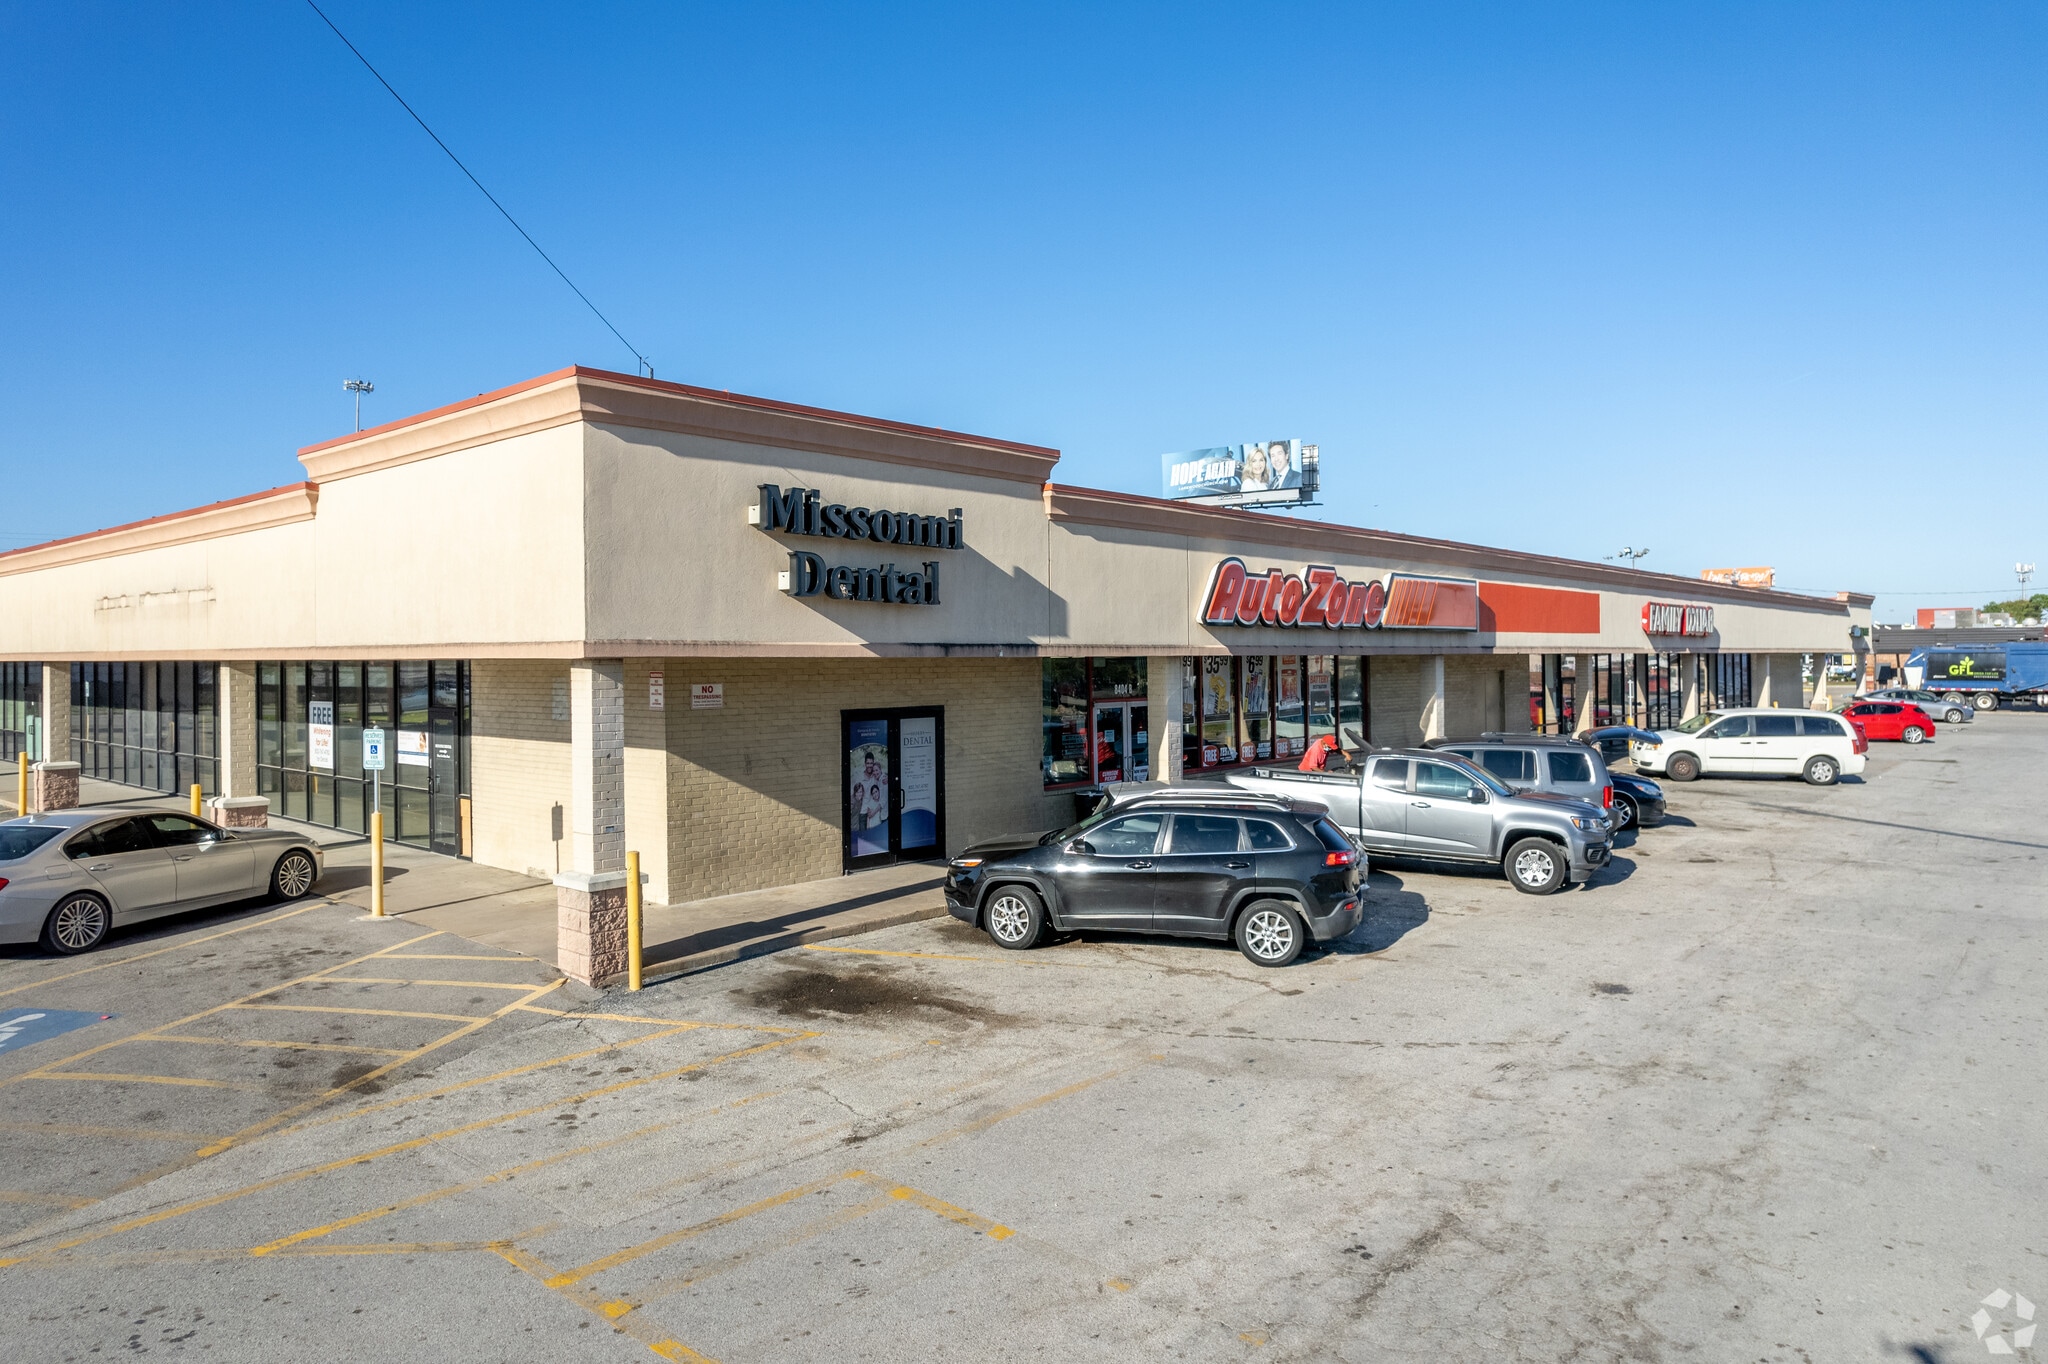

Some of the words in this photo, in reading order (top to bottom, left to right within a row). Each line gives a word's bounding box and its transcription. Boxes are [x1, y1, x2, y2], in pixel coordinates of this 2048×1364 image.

[1170, 460, 1204, 486] HOPE
[1204, 460, 1235, 480] AGAIN
[757, 483, 964, 550] Missonni
[787, 550, 941, 606] Dental
[1203, 557, 1386, 630] AutoZone
[1649, 603, 1684, 633] FAMILY
[1949, 659, 1974, 676] GFL
[1309, 675, 1329, 684] BATTERY
[701, 685, 713, 693] NO
[312, 706, 332, 725] FREE
[903, 736, 932, 746] DENTAL
[1277, 741, 1288, 754] FREE
[1204, 749, 1217, 762] FREE
[1241, 745, 1254, 758] FREE
